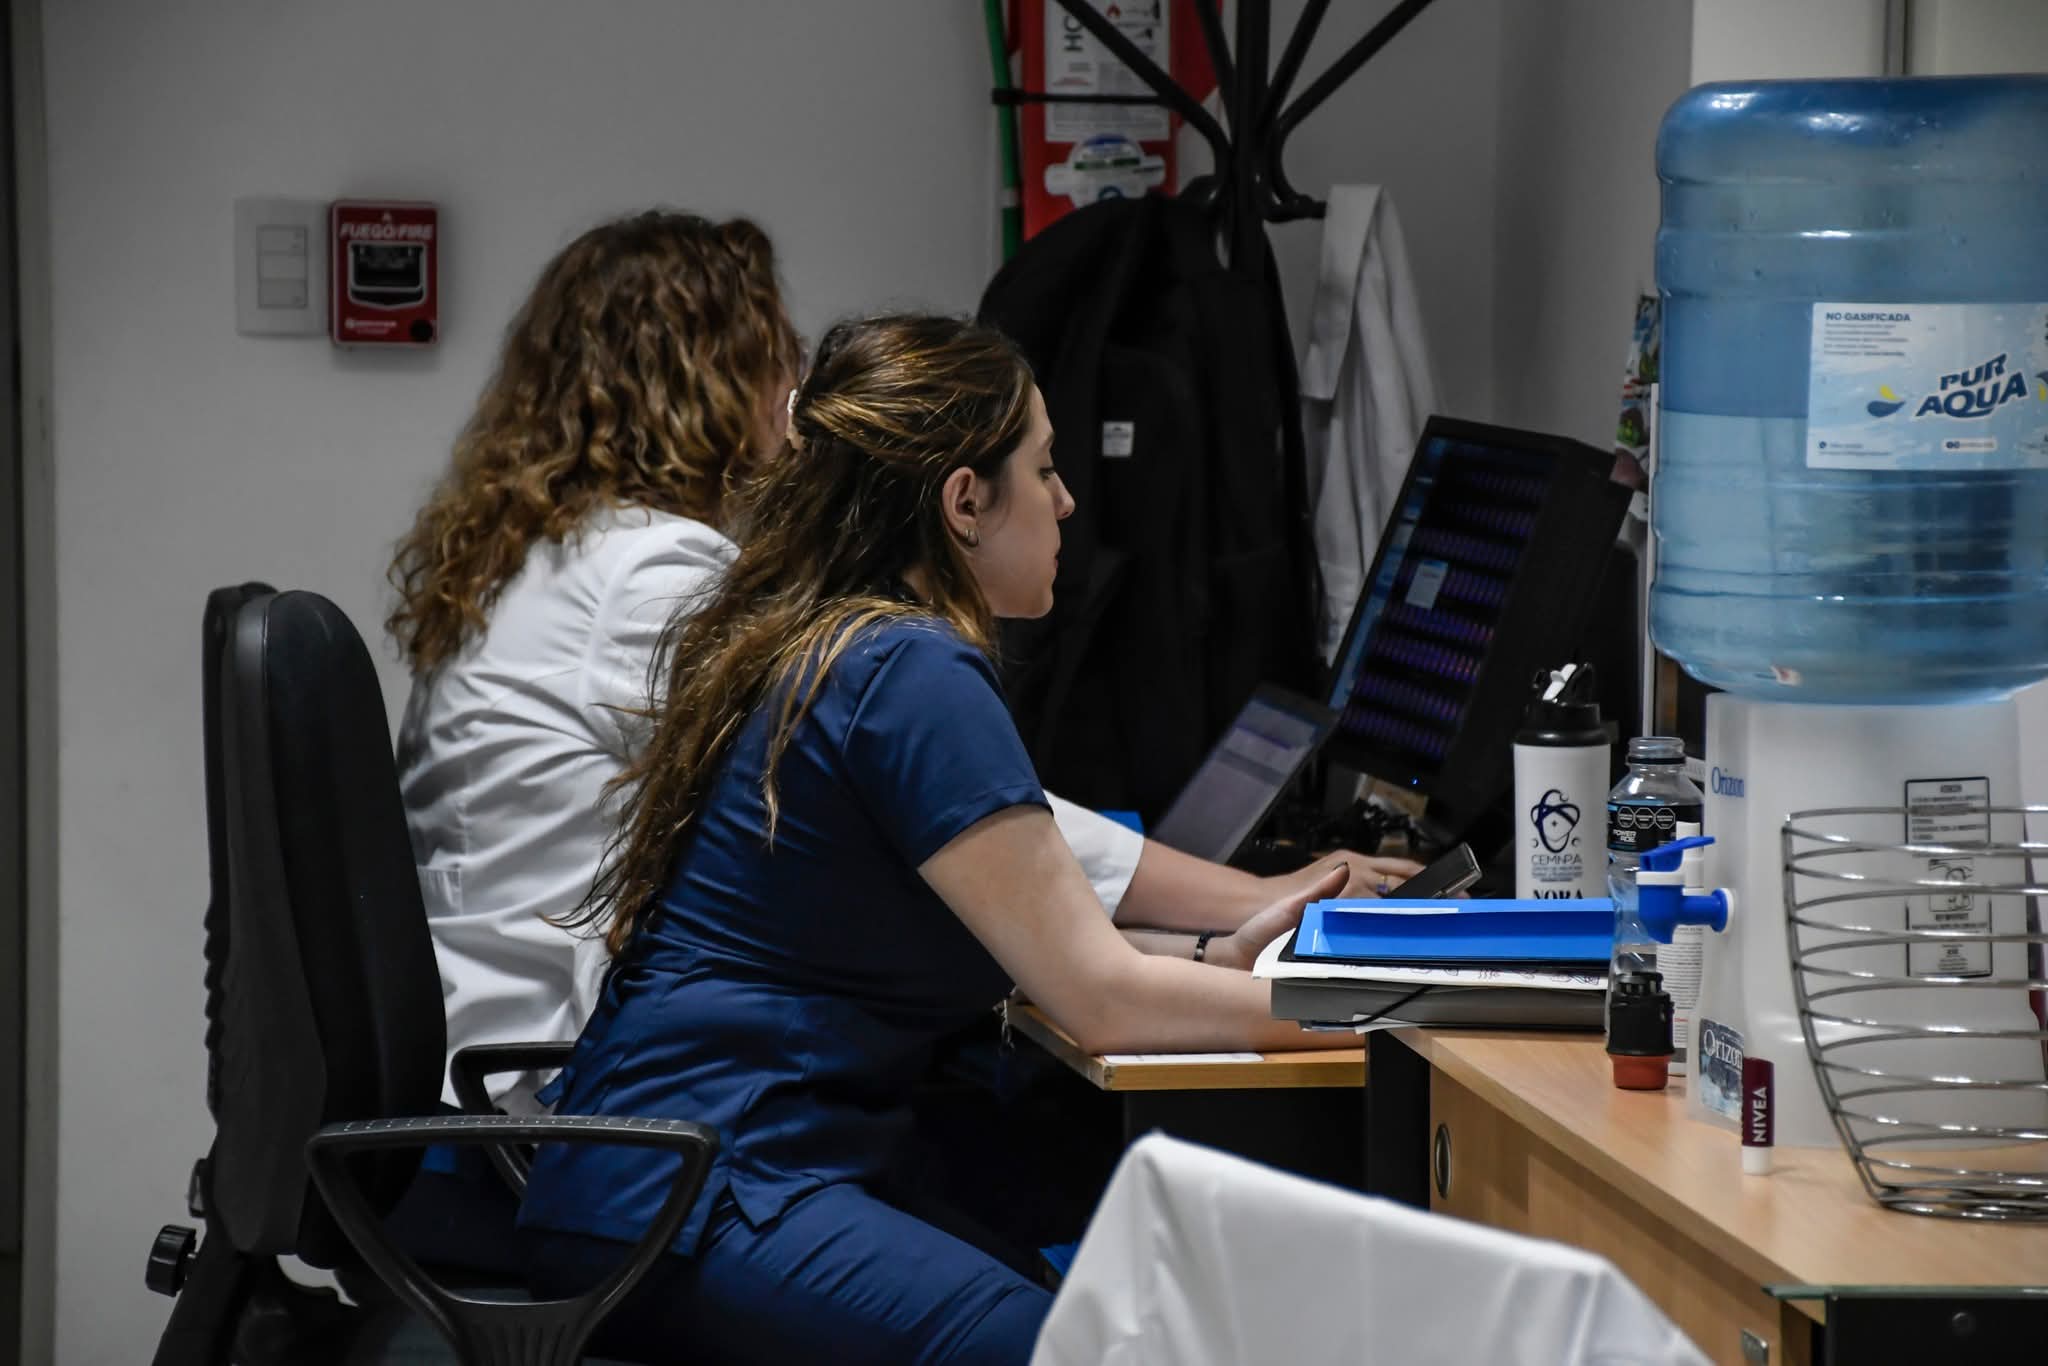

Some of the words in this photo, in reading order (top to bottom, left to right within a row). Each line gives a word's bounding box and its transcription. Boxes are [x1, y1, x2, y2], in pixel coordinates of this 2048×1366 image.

[1826, 312, 1842, 321] NO
[1844, 312, 1911, 322] GASIFICADA
[1940, 353, 2007, 390] PUR
[1915, 372, 2028, 418] AQUA
[1703, 1029, 1743, 1070] Orizon
[1753, 1087, 1767, 1142] NIVEA
